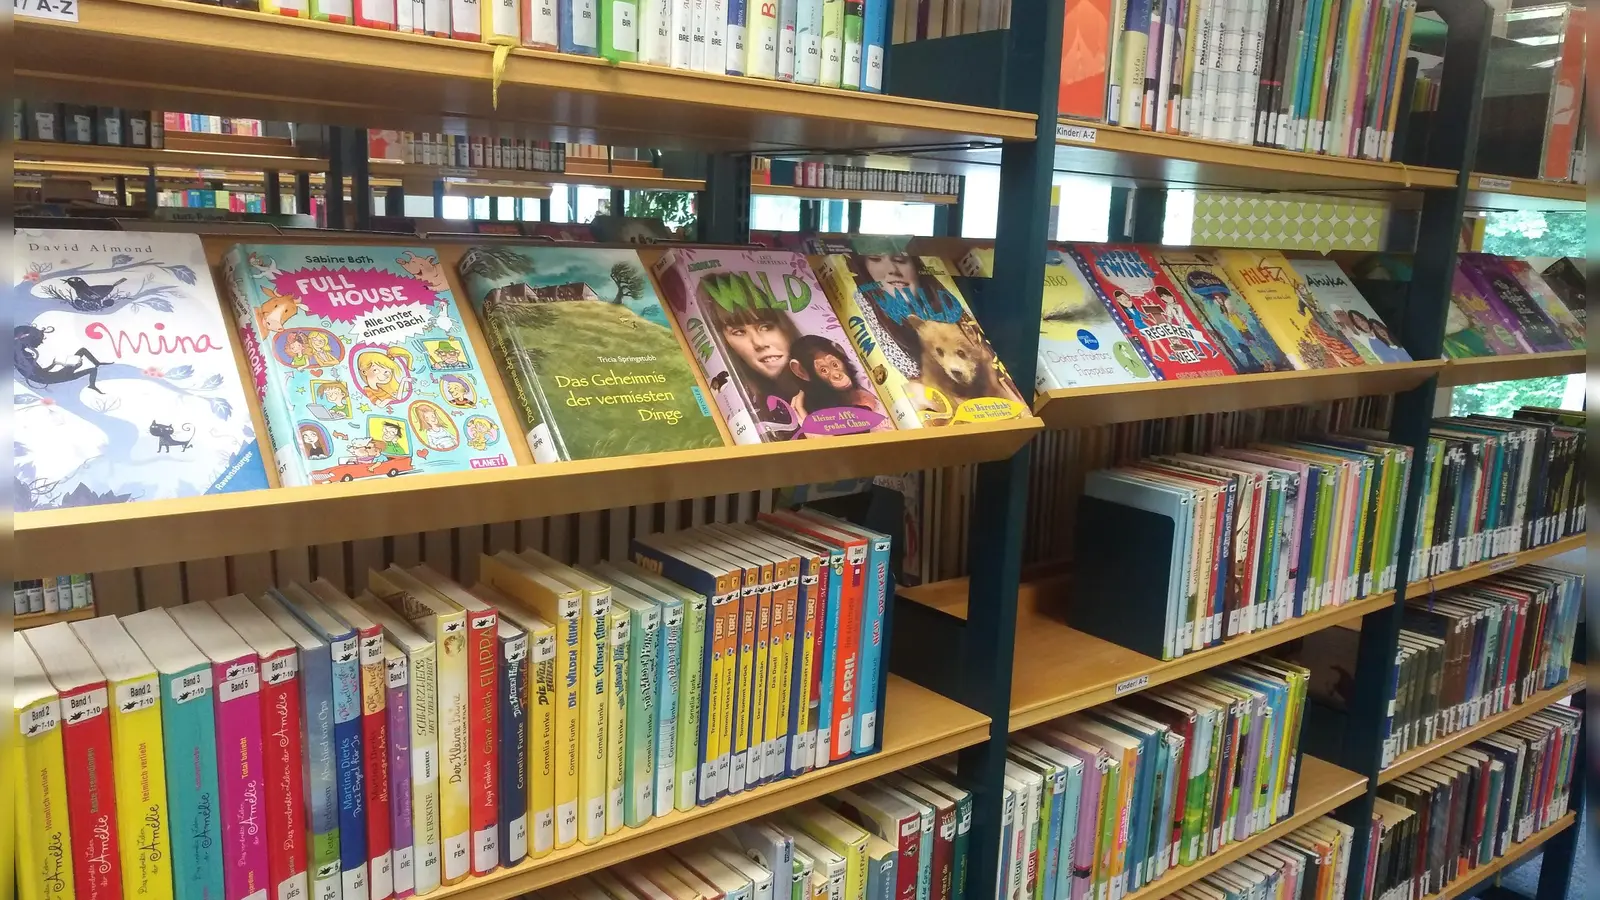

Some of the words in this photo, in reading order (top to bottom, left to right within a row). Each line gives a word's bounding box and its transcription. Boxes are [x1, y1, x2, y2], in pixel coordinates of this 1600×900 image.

[37, 0, 74, 14] A-Z
[542, 8, 552, 16] BIR
[582, 10, 592, 20] BIR
[622, 18, 632, 28] BIR
[678, 34, 690, 42] BRE
[694, 34, 704, 42] BRE
[712, 36, 722, 46] BRE
[1200, 18, 1210, 66] Dummie
[1216, 22, 1226, 68] Dummie
[1253, 32, 1263, 76] Dummie
[1083, 130, 1095, 139] A-Z
[29, 243, 79, 252] David
[90, 244, 152, 253] Almond
[305, 255, 345, 264] Sabine
[347, 255, 374, 264] Both
[1096, 260, 1159, 279] TWINS
[296, 274, 356, 295] FULL
[700, 271, 812, 313] WILD
[329, 286, 408, 307] HOUSE
[872, 288, 964, 326] WILD
[363, 325, 396, 338] einem
[398, 316, 426, 330] Dach!
[364, 315, 383, 328] Alle
[385, 310, 413, 324] unter
[85, 322, 224, 358] Mina
[686, 317, 714, 364] WILD
[848, 316, 876, 357] WILD
[1145, 324, 1194, 340] REGIEREN
[618, 354, 656, 365] Springstubb
[1176, 350, 1199, 362] WELT
[554, 374, 589, 388] Das
[592, 370, 666, 386] Geheimnis
[566, 389, 591, 407] der
[596, 391, 675, 405] vermissten
[525, 407, 535, 424] Das
[639, 408, 683, 425] Dinge
[812, 414, 836, 422] Kleiner
[838, 410, 859, 421] Affe,
[736, 425, 746, 435] COU
[824, 422, 846, 432] großes
[847, 419, 870, 429] Chaos
[470, 454, 508, 468] PLANET!
[215, 450, 253, 490] Ravensburger
[272, 659, 283, 672] Band
[283, 659, 287, 667] 1
[480, 628, 495, 687] FILIPPA
[242, 666, 254, 674] 7-10
[282, 670, 294, 679] 7-10
[391, 671, 401, 682] Band
[566, 650, 577, 688] WILDEN
[842, 652, 855, 702] APRIL
[183, 676, 196, 688] Band
[196, 674, 200, 683] 3
[231, 680, 245, 692] Band
[244, 680, 248, 688] 5
[1139, 676, 1148, 684] A-Z
[130, 685, 145, 697] Band
[146, 684, 151, 693] 2
[192, 687, 204, 696] 7-10
[71, 696, 85, 708] Band
[87, 696, 91, 704] 1
[140, 698, 154, 707] 7-10
[319, 700, 327, 721] Opa
[32, 708, 45, 721] Band
[45, 706, 50, 715] 2
[86, 707, 101, 716] 7-10
[272, 692, 288, 748] Amélie
[41, 720, 55, 729] 7-10
[240, 737, 248, 761] beliebt
[351, 735, 360, 749] Jo
[450, 727, 461, 763] Kleine
[484, 729, 492, 754] Ganz
[138, 742, 148, 772] verliebt
[282, 748, 290, 763] der
[320, 739, 329, 781] Abschied
[342, 738, 351, 769] Dierks
[449, 762, 461, 785] Der
[720, 762, 728, 770] GAR
[139, 773, 149, 803] Heimlich
[352, 767, 363, 793] Engel
[353, 795, 362, 818] Drei
[485, 790, 495, 807] Anja
[44, 797, 52, 831] Heimlich
[240, 780, 258, 835] Amélie
[193, 792, 212, 848] Amélie
[566, 816, 575, 825] FUN
[140, 804, 162, 862] Amélie
[284, 829, 294, 850] Das
[88, 815, 111, 874] Amélie
[45, 832, 65, 892] Amélie
[425, 857, 436, 866] ERS
[454, 850, 465, 858] FEN
[401, 860, 410, 869] DIE
[354, 879, 363, 889] DIE
[287, 889, 300, 899] DES
